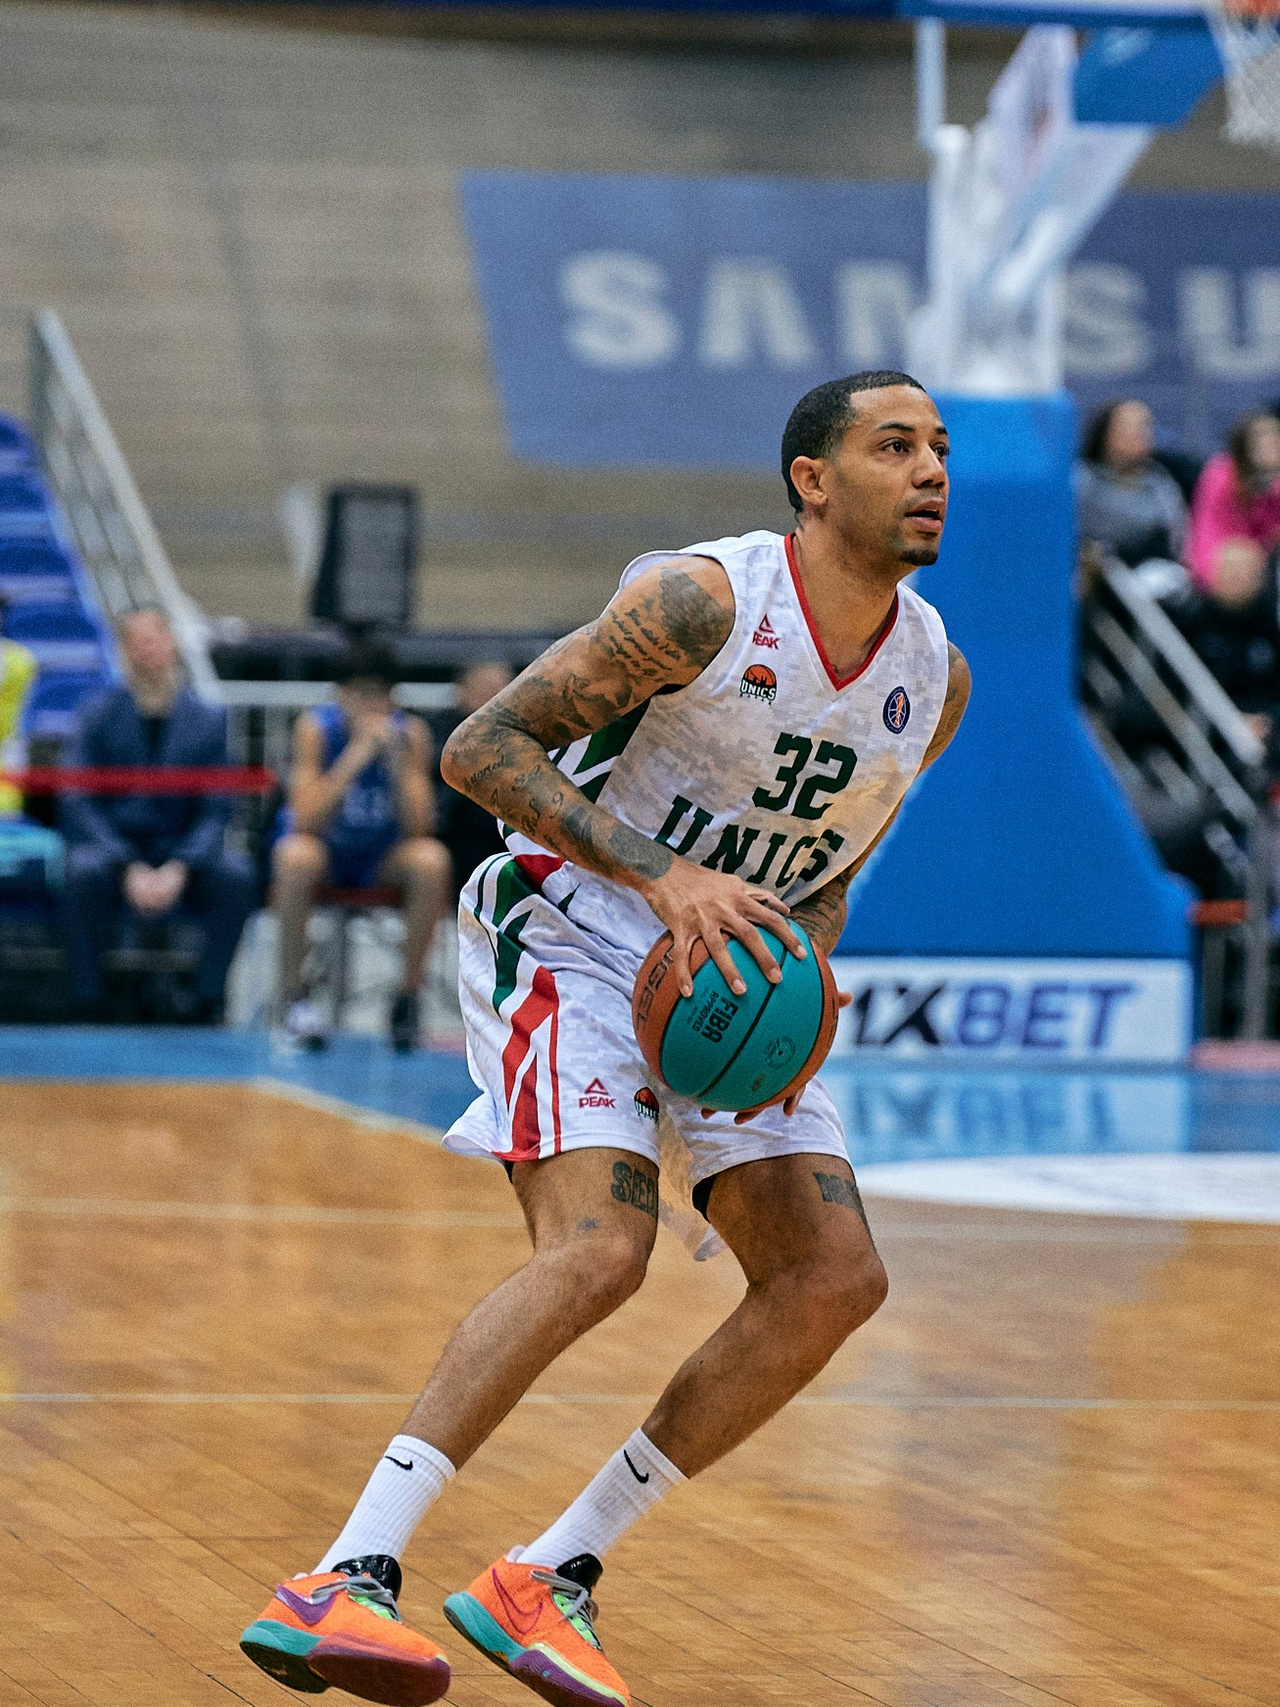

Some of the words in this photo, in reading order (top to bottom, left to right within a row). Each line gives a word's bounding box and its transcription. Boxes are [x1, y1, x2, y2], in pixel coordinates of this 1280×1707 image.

[741, 679, 776, 700] UNICS
[752, 732, 858, 821] 32
[653, 794, 845, 888] UNICS
[691, 989, 720, 1033] APPROVED
[701, 995, 740, 1044] FIBA
[852, 979, 1134, 1047] 1XBET
[578, 1096, 617, 1110] PEAK
